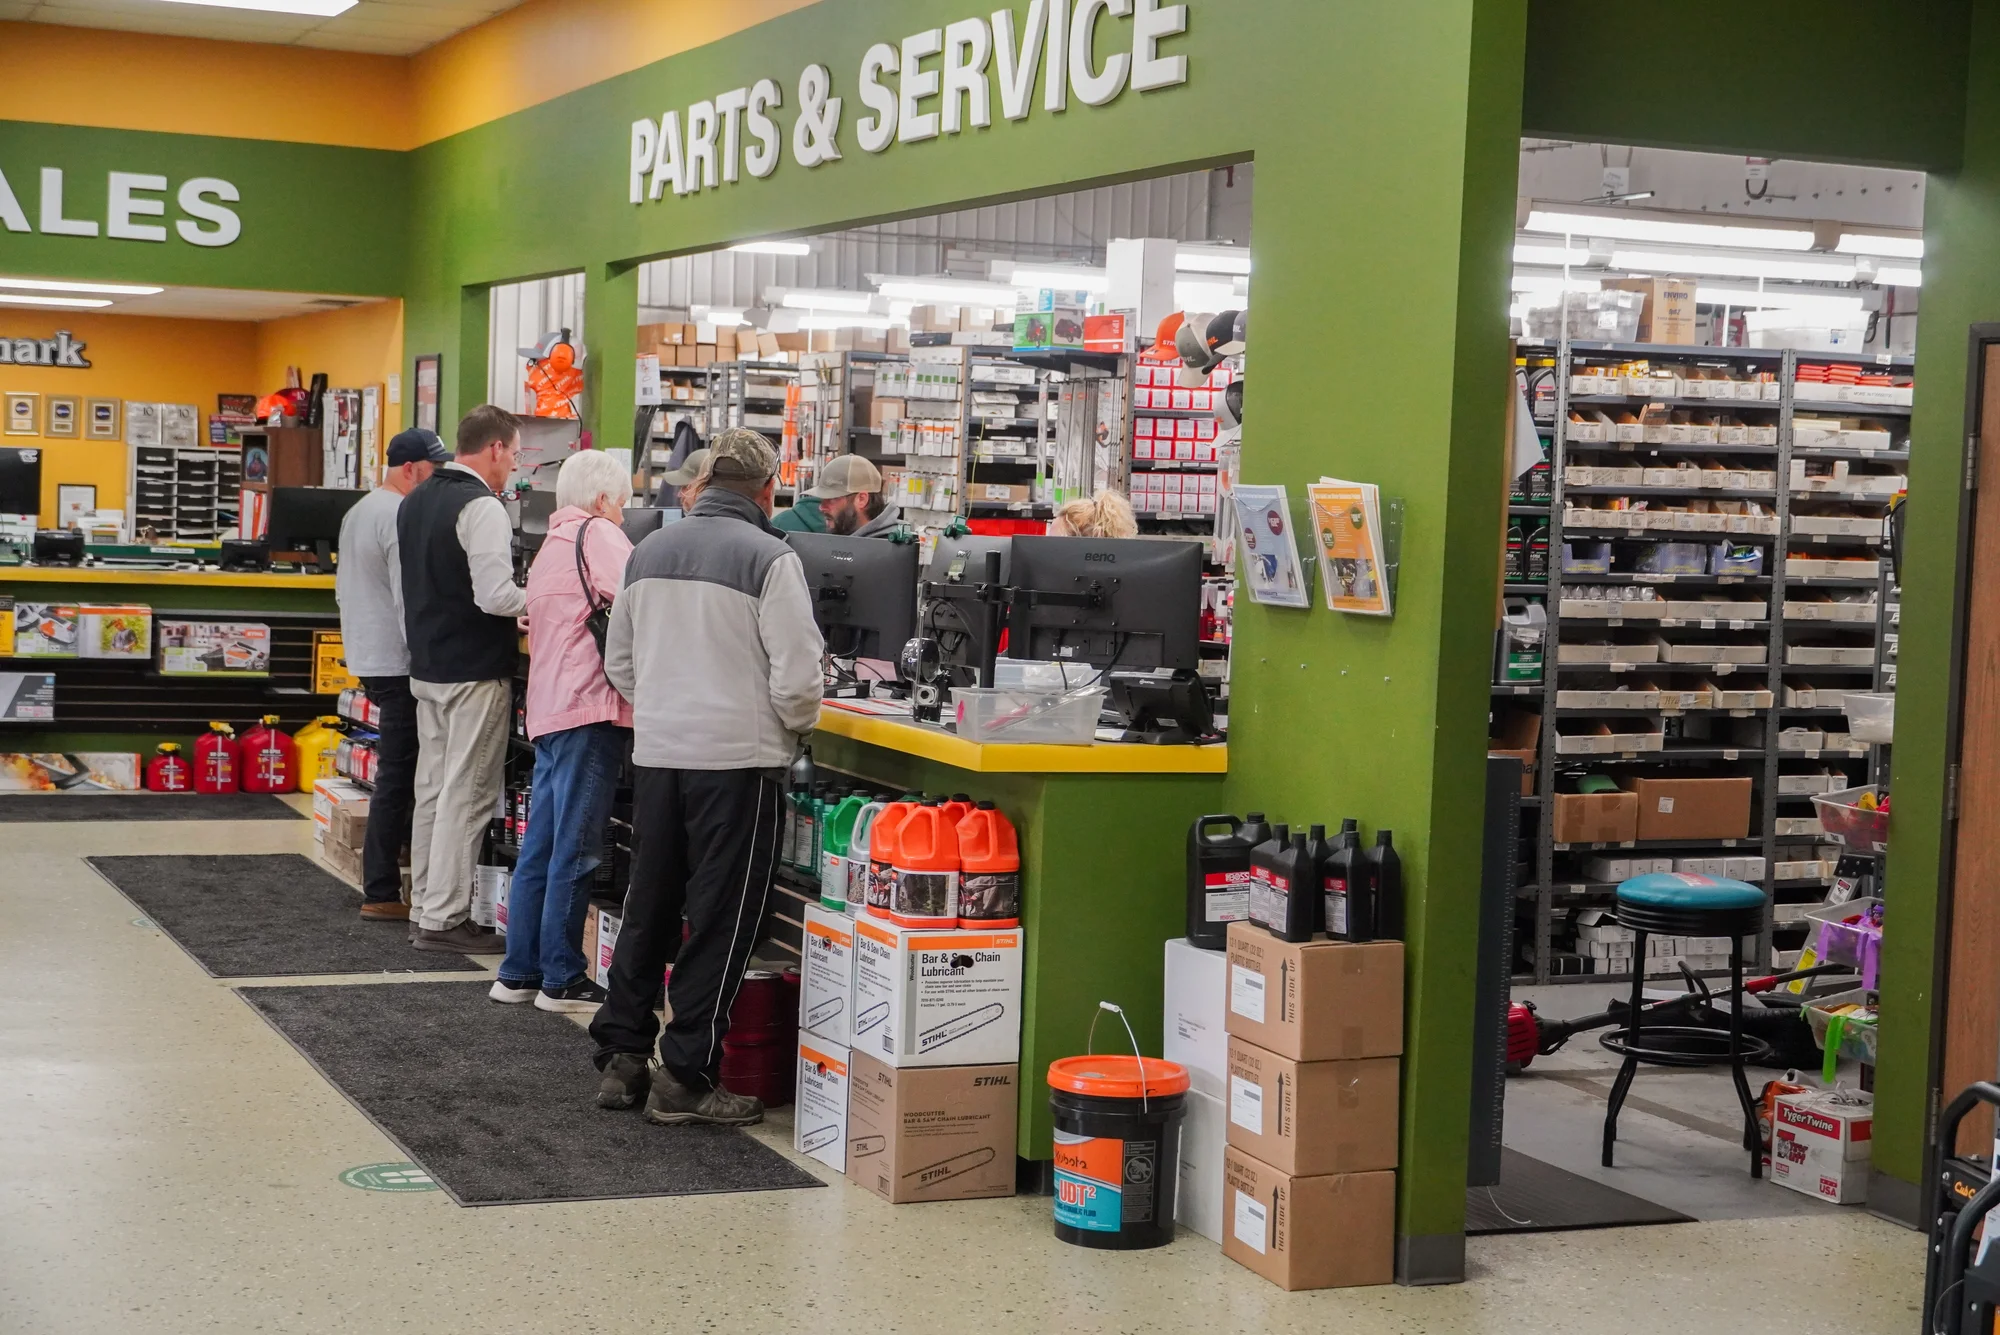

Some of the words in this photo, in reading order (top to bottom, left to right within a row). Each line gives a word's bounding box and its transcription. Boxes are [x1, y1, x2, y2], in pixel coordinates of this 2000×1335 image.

[630, 78, 783, 204] PARTS
[793, 63, 843, 168] &
[857, 0, 1189, 153] SERVICE
[1084, 552, 1117, 563] BenQ
[810, 949, 828, 964] Lubricant
[832, 944, 843, 958] Chain
[871, 941, 880, 954] Saw
[879, 944, 891, 960] Chain
[922, 953, 939, 964] Bar
[940, 952, 949, 963] &
[974, 951, 1001, 962] Chain
[859, 952, 876, 967] Lubricant
[1289, 958, 1296, 972] UP
[921, 966, 965, 977] Lubricant
[1288, 977, 1296, 999] SIDE
[1288, 1002, 1296, 1024] THIS
[921, 1030, 948, 1047] STIHL
[804, 1061, 812, 1073] Bar
[827, 1070, 839, 1085] Chain
[878, 1072, 893, 1088] STIHL
[1285, 1073, 1292, 1087] UP
[804, 1074, 823, 1091] Lubricant
[973, 1076, 1011, 1087] STIHL
[1783, 1107, 1807, 1124] Tyger
[1806, 1114, 1834, 1132] Twine
[856, 1143, 869, 1151] STIHL
[1055, 1150, 1089, 1169] Kubota
[920, 1166, 952, 1182] STIHL
[1279, 1187, 1286, 1201] UP
[1819, 1184, 1837, 1197] USA
[1954, 1180, 1969, 1197] Cub
[1278, 1204, 1286, 1227] SIDE
[1278, 1229, 1286, 1252] THIS
